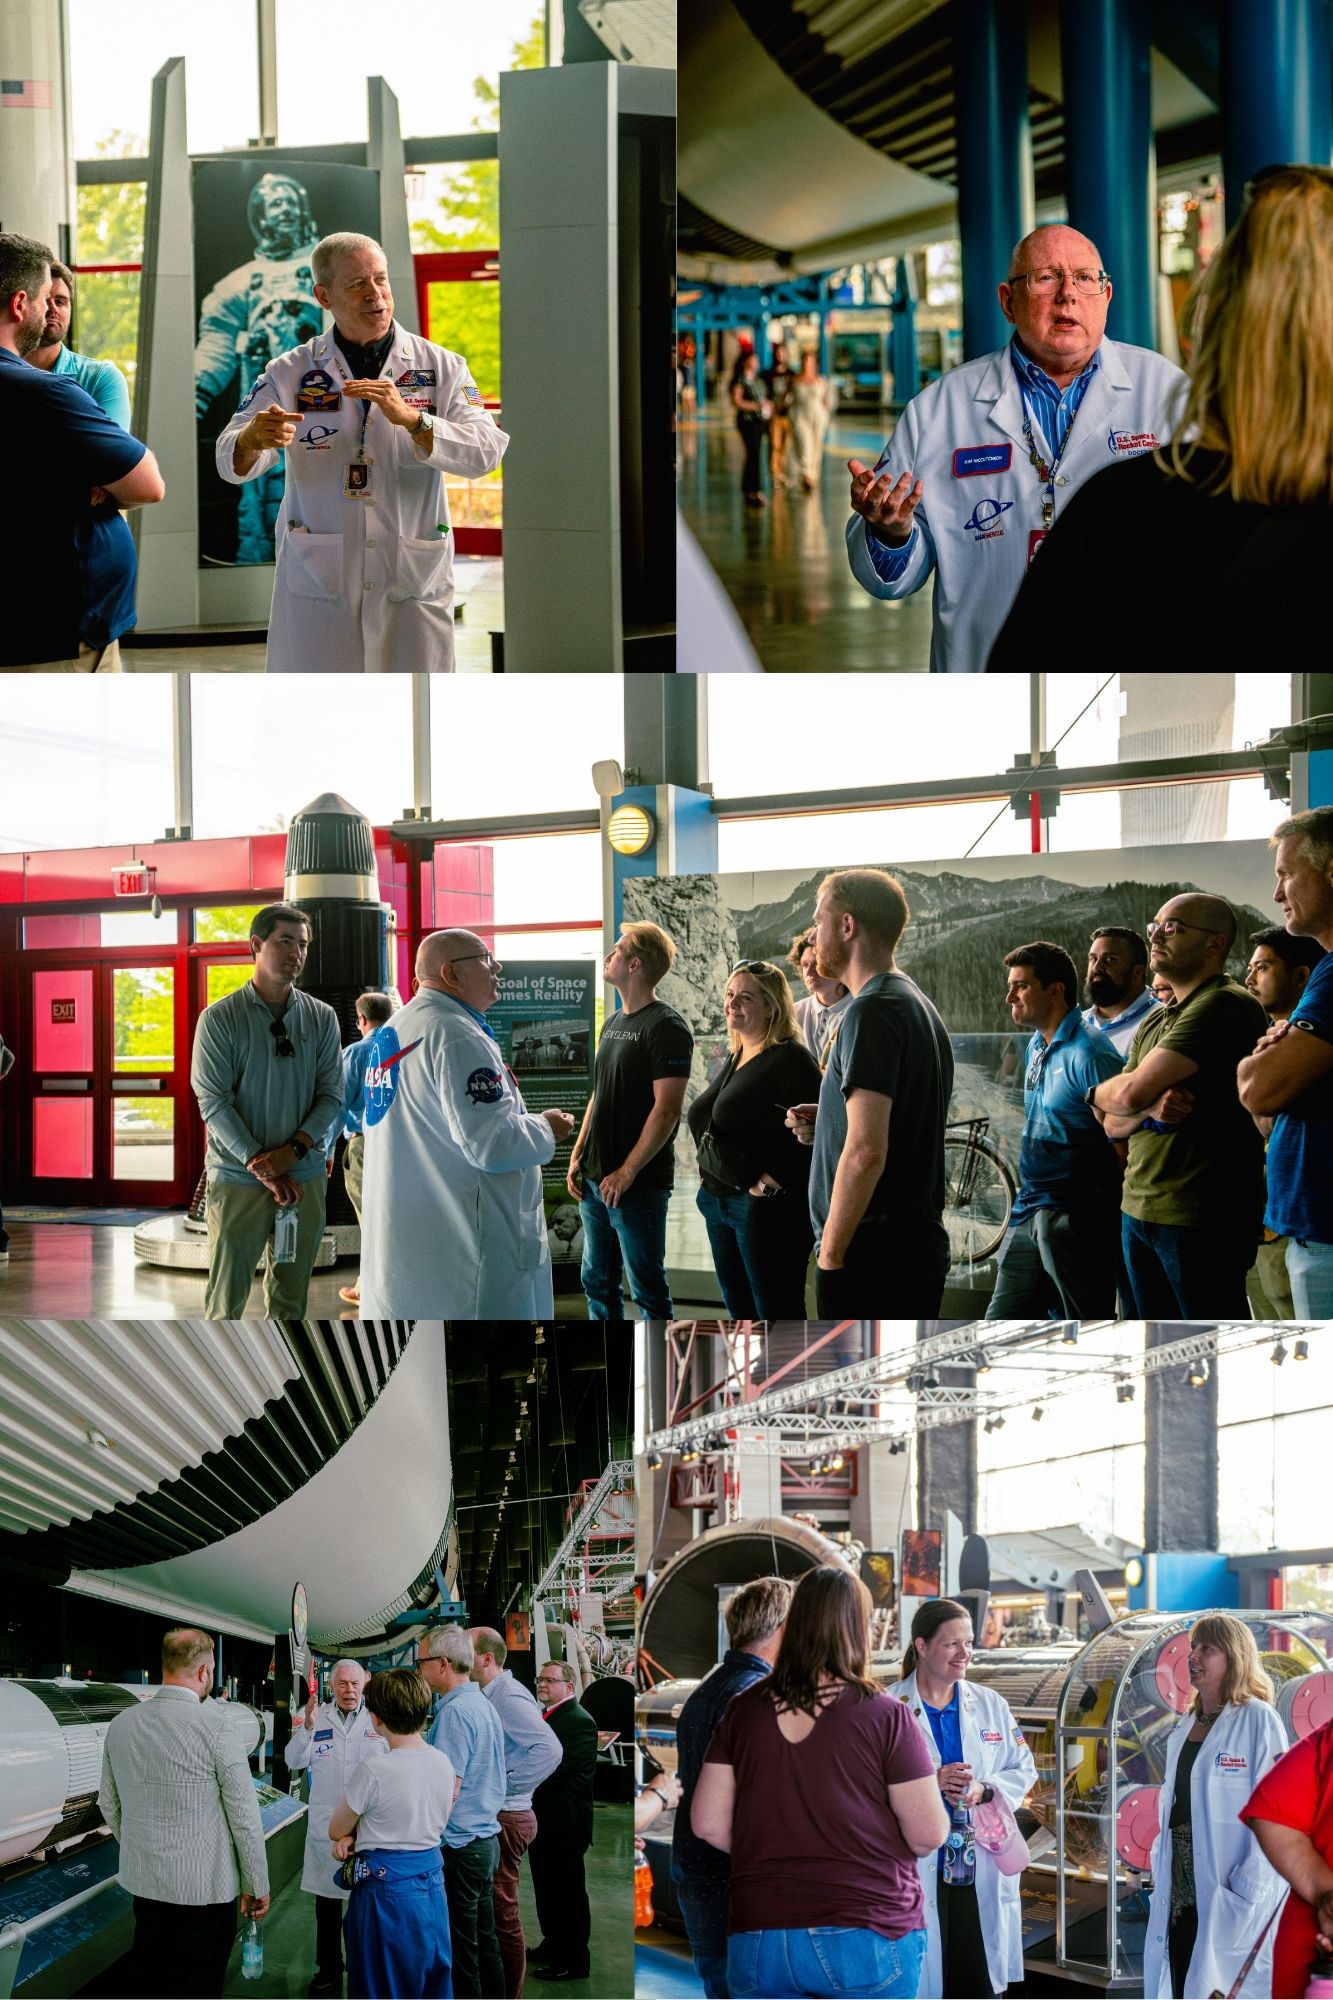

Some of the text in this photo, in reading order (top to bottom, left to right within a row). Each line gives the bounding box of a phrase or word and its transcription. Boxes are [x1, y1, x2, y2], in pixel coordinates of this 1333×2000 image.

[1131, 433, 1150, 441] Space
[1118, 441, 1141, 450] Rocket
[120, 873, 143, 894] EXIT
[497, 976, 587, 991] Goal of Space
[534, 989, 584, 1003] Reality
[53, 1004, 75, 1017] EXIT
[470, 1081, 502, 1093] NASA
